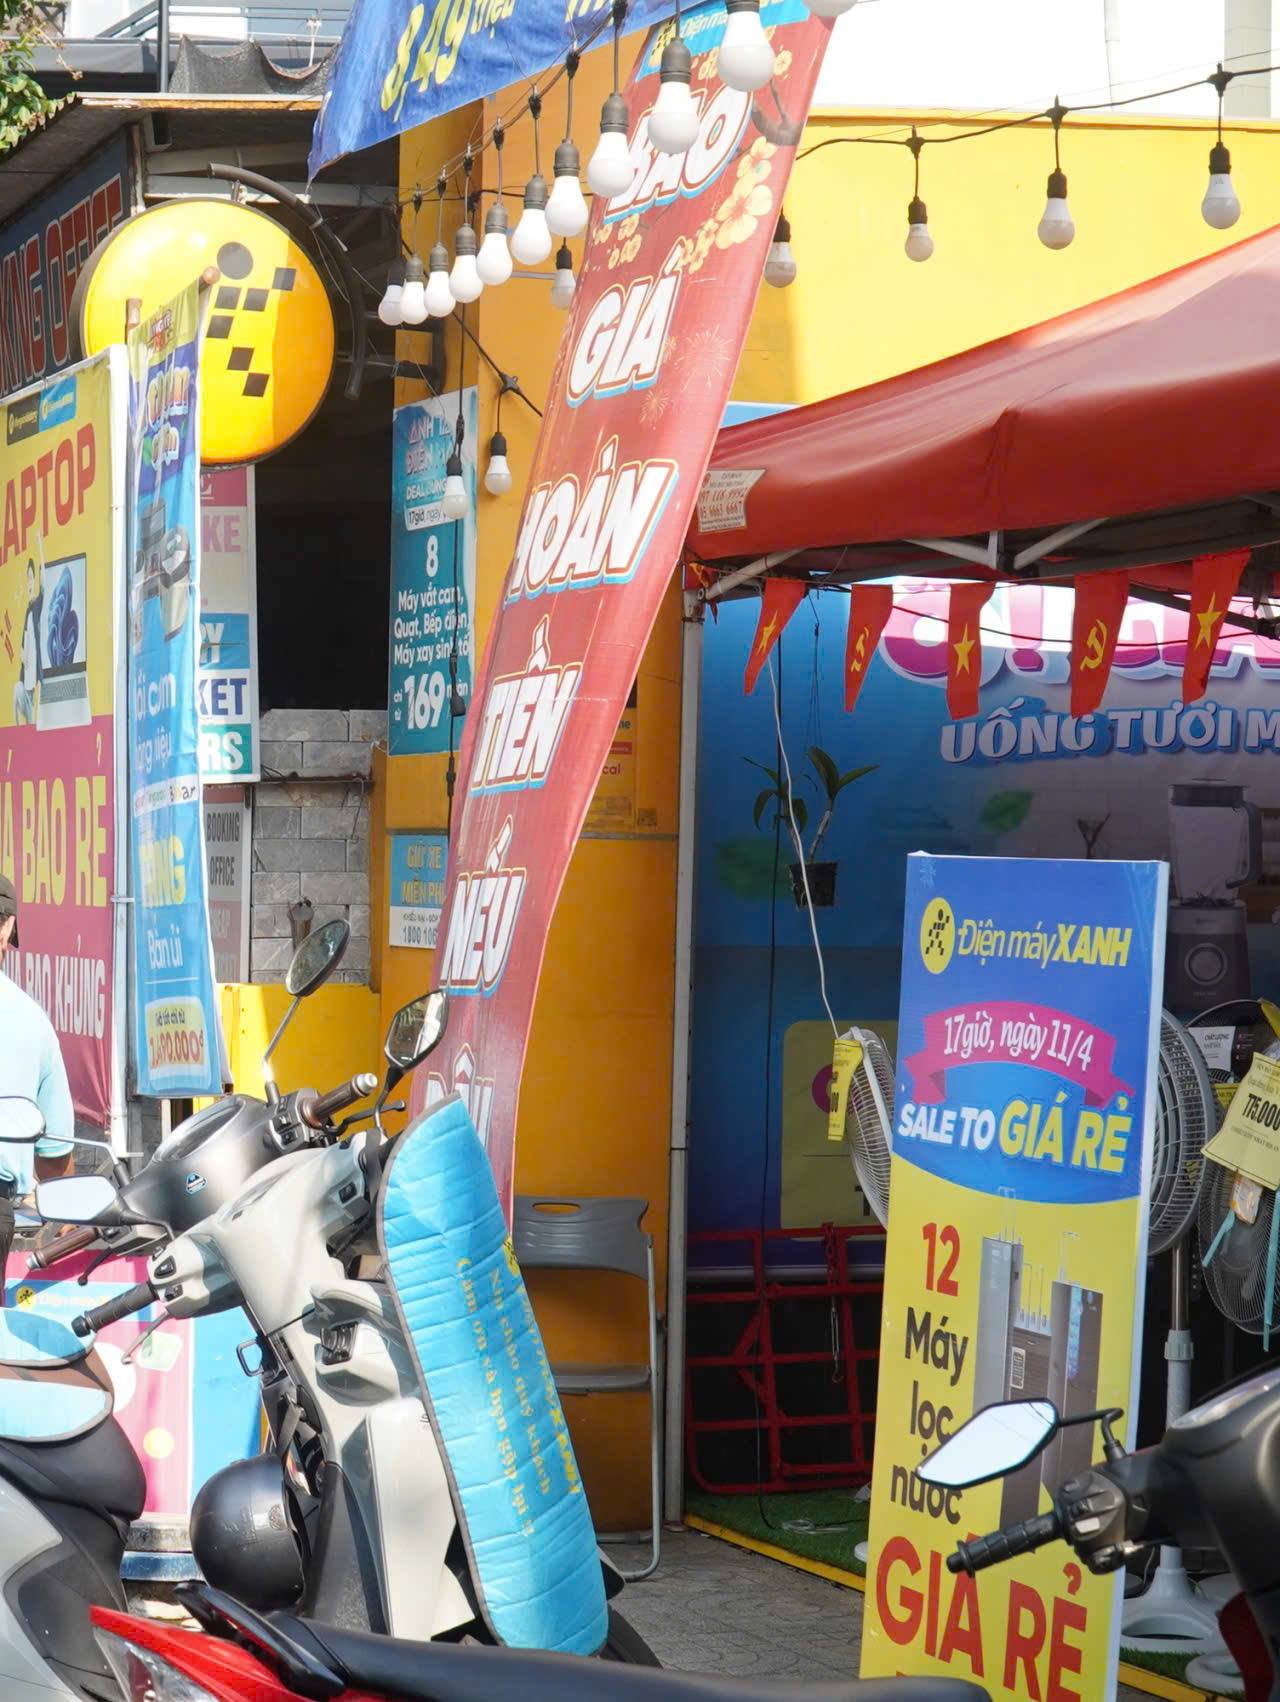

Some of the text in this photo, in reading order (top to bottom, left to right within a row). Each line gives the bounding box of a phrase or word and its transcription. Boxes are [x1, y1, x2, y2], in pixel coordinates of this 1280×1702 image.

[566, 237, 685, 407] GIÁ
[202, 514, 241, 553] KE
[426, 534, 439, 578] 8
[394, 616, 422, 643] Quạt,
[423, 610, 442, 637] Bếp
[398, 587, 418, 614] Máy
[421, 581, 437, 608] vắt
[394, 643, 415, 669] Máy
[417, 644, 434, 665] xay
[457, 631, 470, 657] tố
[404, 670, 446, 731] 169
[471, 614, 583, 796] TIỀN
[940, 697, 1280, 763] UỐNG TƯƠI M
[22, 777, 68, 906] BAO
[74, 732, 107, 907] RẺ
[207, 812, 240, 843] BOOKING
[210, 855, 235, 886] OFFICE
[403, 927, 421, 945] 1800
[440, 815, 526, 996] NẾU
[958, 918, 1006, 966] Điện
[55, 935, 106, 1040] KHỦNG
[944, 1010, 1095, 1071] 17giờ, ngày 11/4
[898, 1091, 1132, 1173] SALE TO GIÁ RẺ
[922, 1221, 961, 1297] 12
[904, 1306, 969, 1387] Máy
[910, 1381, 954, 1457] lọc
[876, 1533, 1088, 1702] GIÁ RẺ
